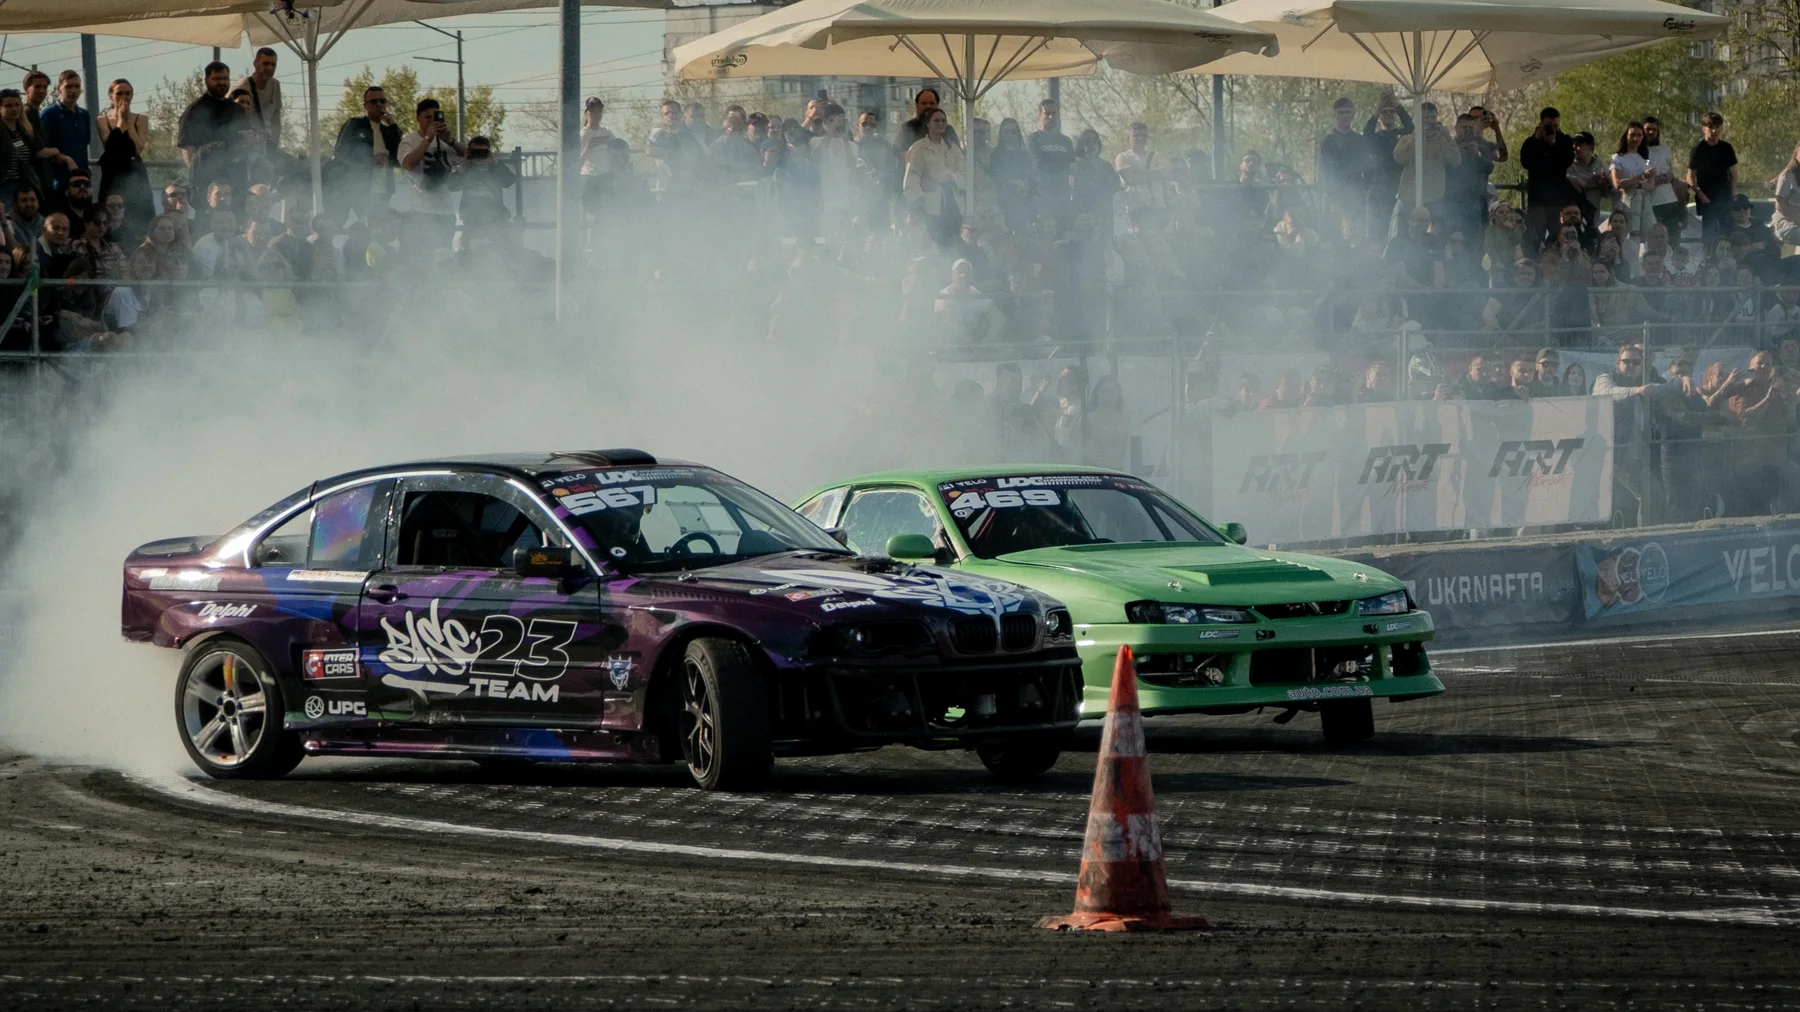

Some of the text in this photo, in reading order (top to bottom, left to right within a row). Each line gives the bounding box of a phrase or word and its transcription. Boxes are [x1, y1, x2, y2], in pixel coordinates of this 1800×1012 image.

[559, 485, 656, 516] 567
[950, 489, 1061, 510] 469
[1428, 572, 1543, 605] UKRNAFTA
[198, 603, 257, 618] Delphi
[820, 598, 877, 612] Delphi
[469, 614, 578, 681] 23
[324, 653, 354, 662] INTER
[325, 663, 354, 674] CARS
[469, 678, 560, 702] TEAM
[1287, 685, 1373, 700] auto.com.ua
[328, 700, 367, 715] UPG
